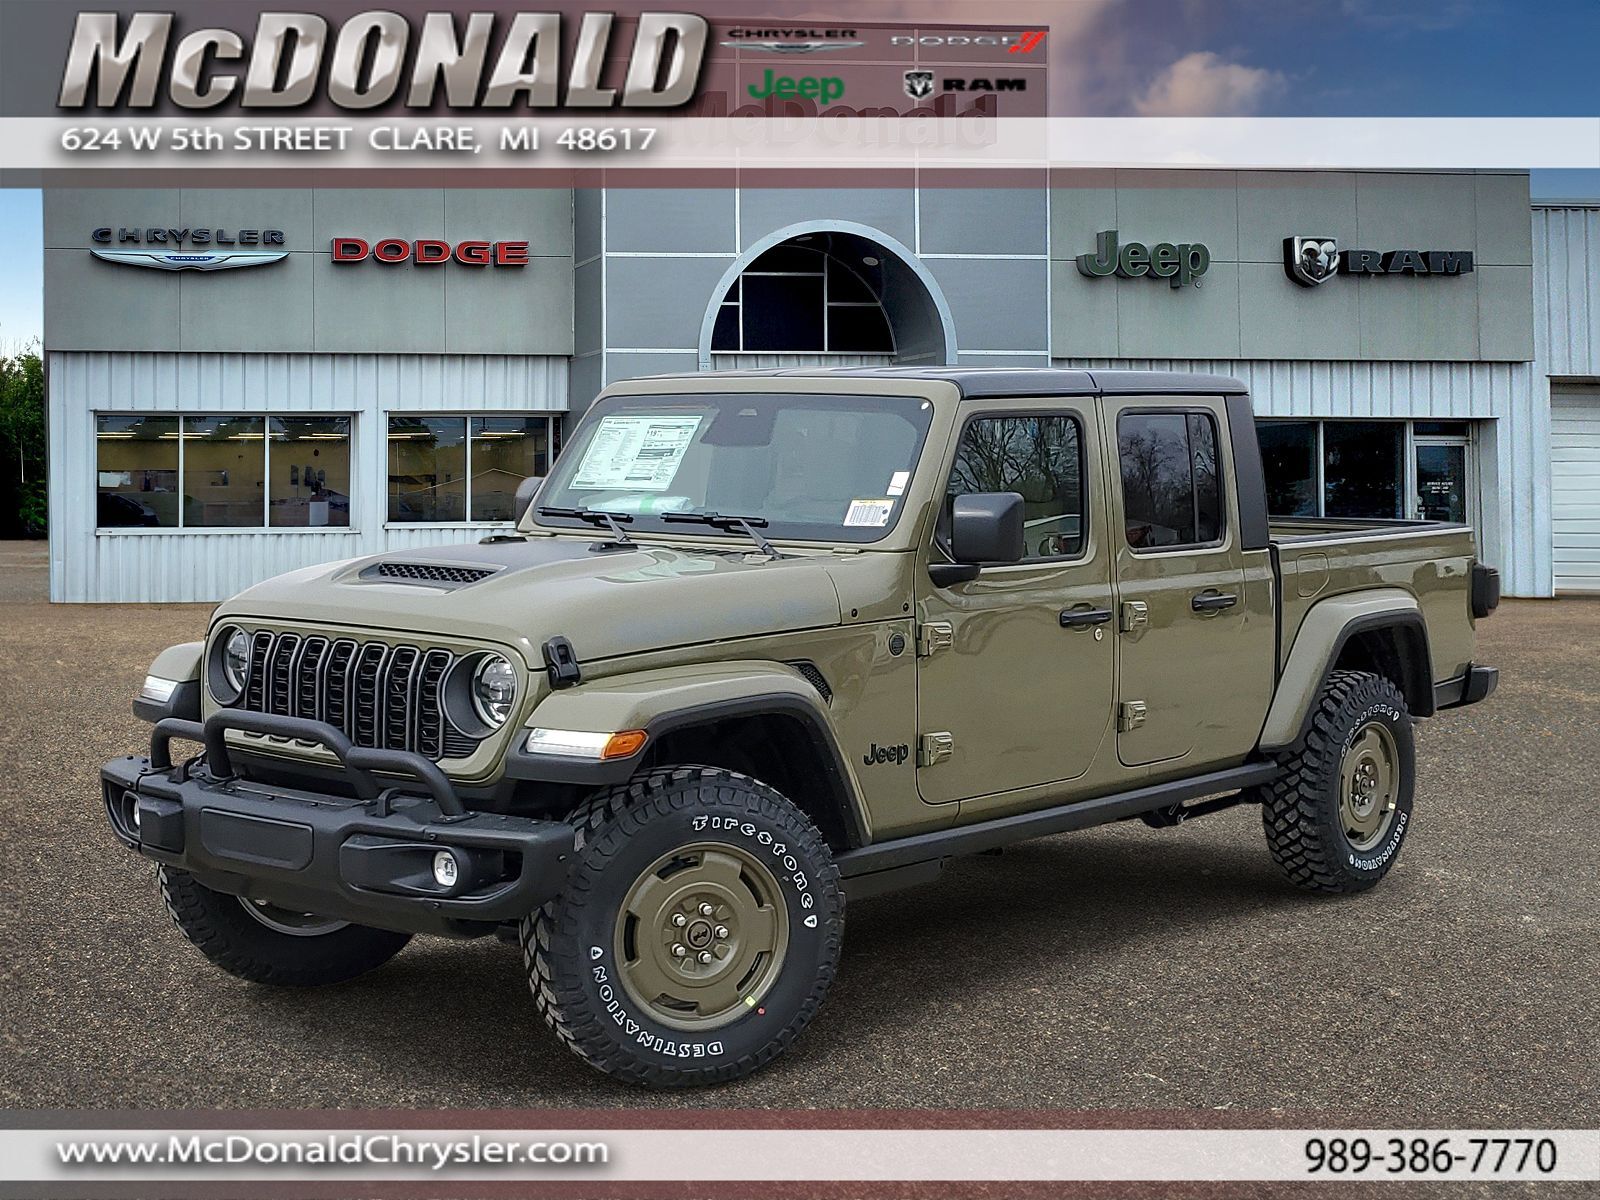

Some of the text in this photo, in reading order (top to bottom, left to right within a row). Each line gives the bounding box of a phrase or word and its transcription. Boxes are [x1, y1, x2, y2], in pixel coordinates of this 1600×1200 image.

[727, 29, 857, 39] CHRYSLER
[747, 69, 845, 104] Jeep
[943, 78, 1026, 92] RAM
[91, 226, 286, 245] CHRYSLER
[331, 237, 530, 267] DODGE
[1077, 229, 1211, 288] Jeep
[1344, 250, 1475, 274] RAM
[863, 743, 909, 766] Jeep
[692, 814, 814, 909] Firestone
[592, 965, 744, 1058] DESTINATION
